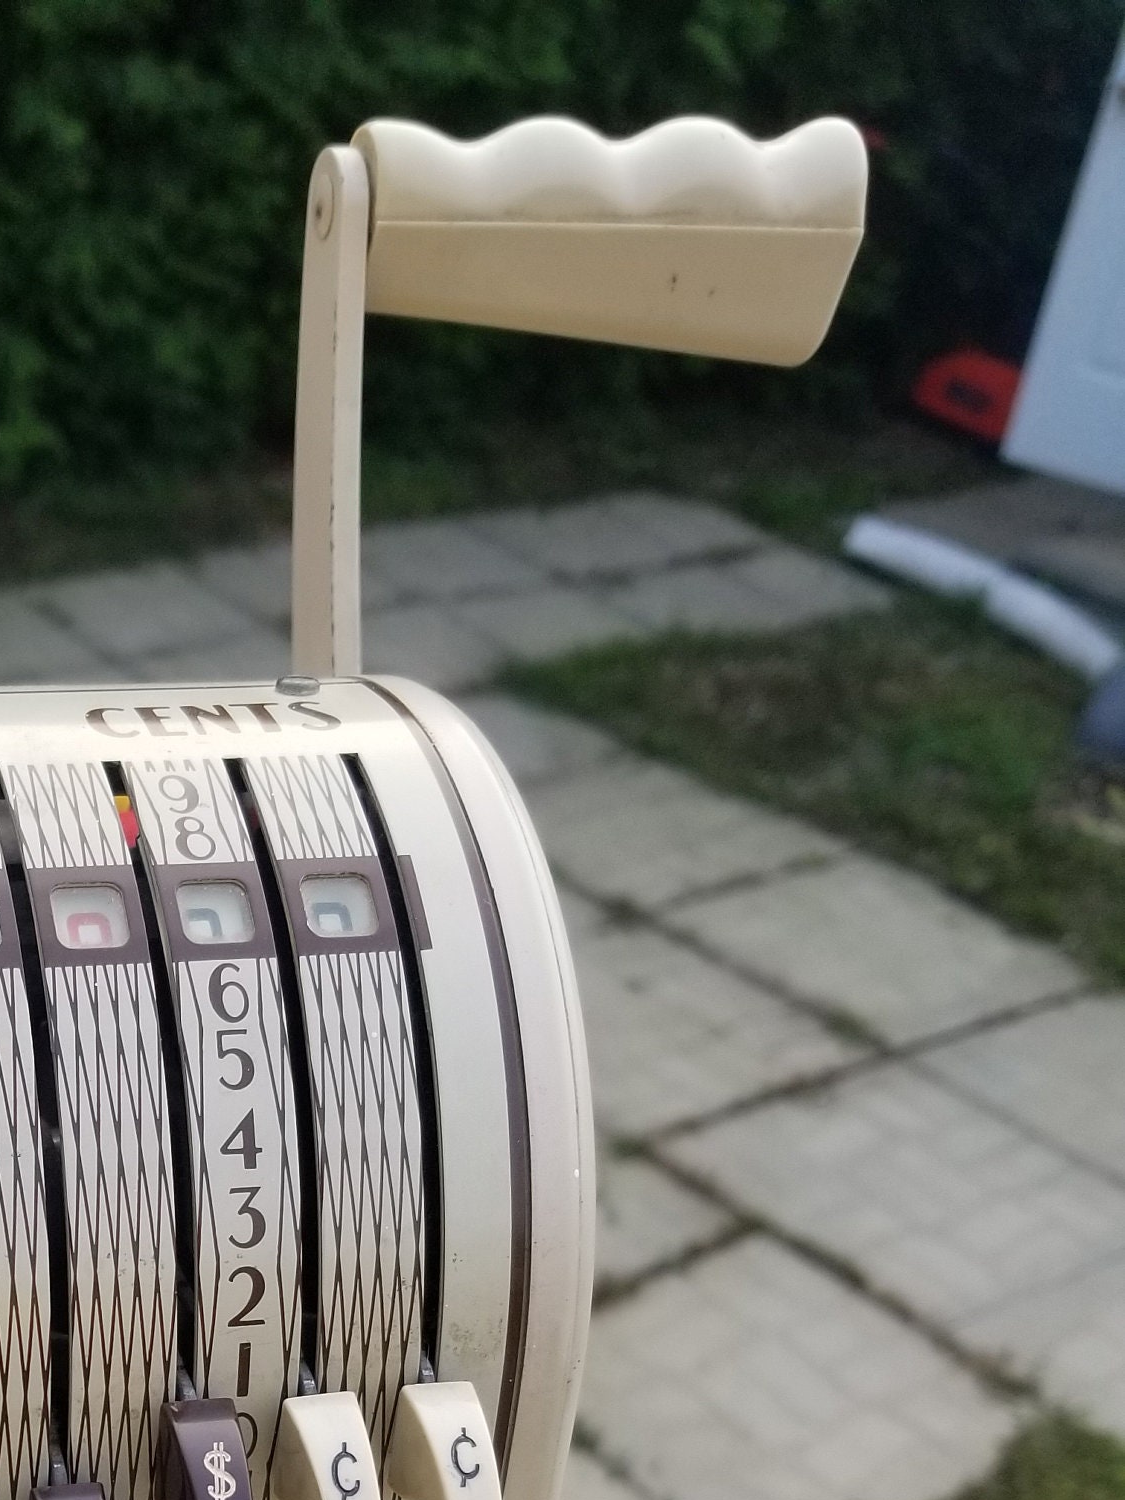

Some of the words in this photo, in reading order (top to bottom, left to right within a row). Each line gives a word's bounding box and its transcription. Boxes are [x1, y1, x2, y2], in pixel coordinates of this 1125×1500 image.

[84, 701, 342, 739] CENTS
[158, 775, 200, 814] 9
[175, 816, 216, 861] 8
[208, 963, 251, 1024] 6
[216, 1029, 255, 1091] 5
[219, 1108, 263, 1170] 4
[228, 1186, 266, 1249] 3
[227, 1266, 266, 1328] 2
